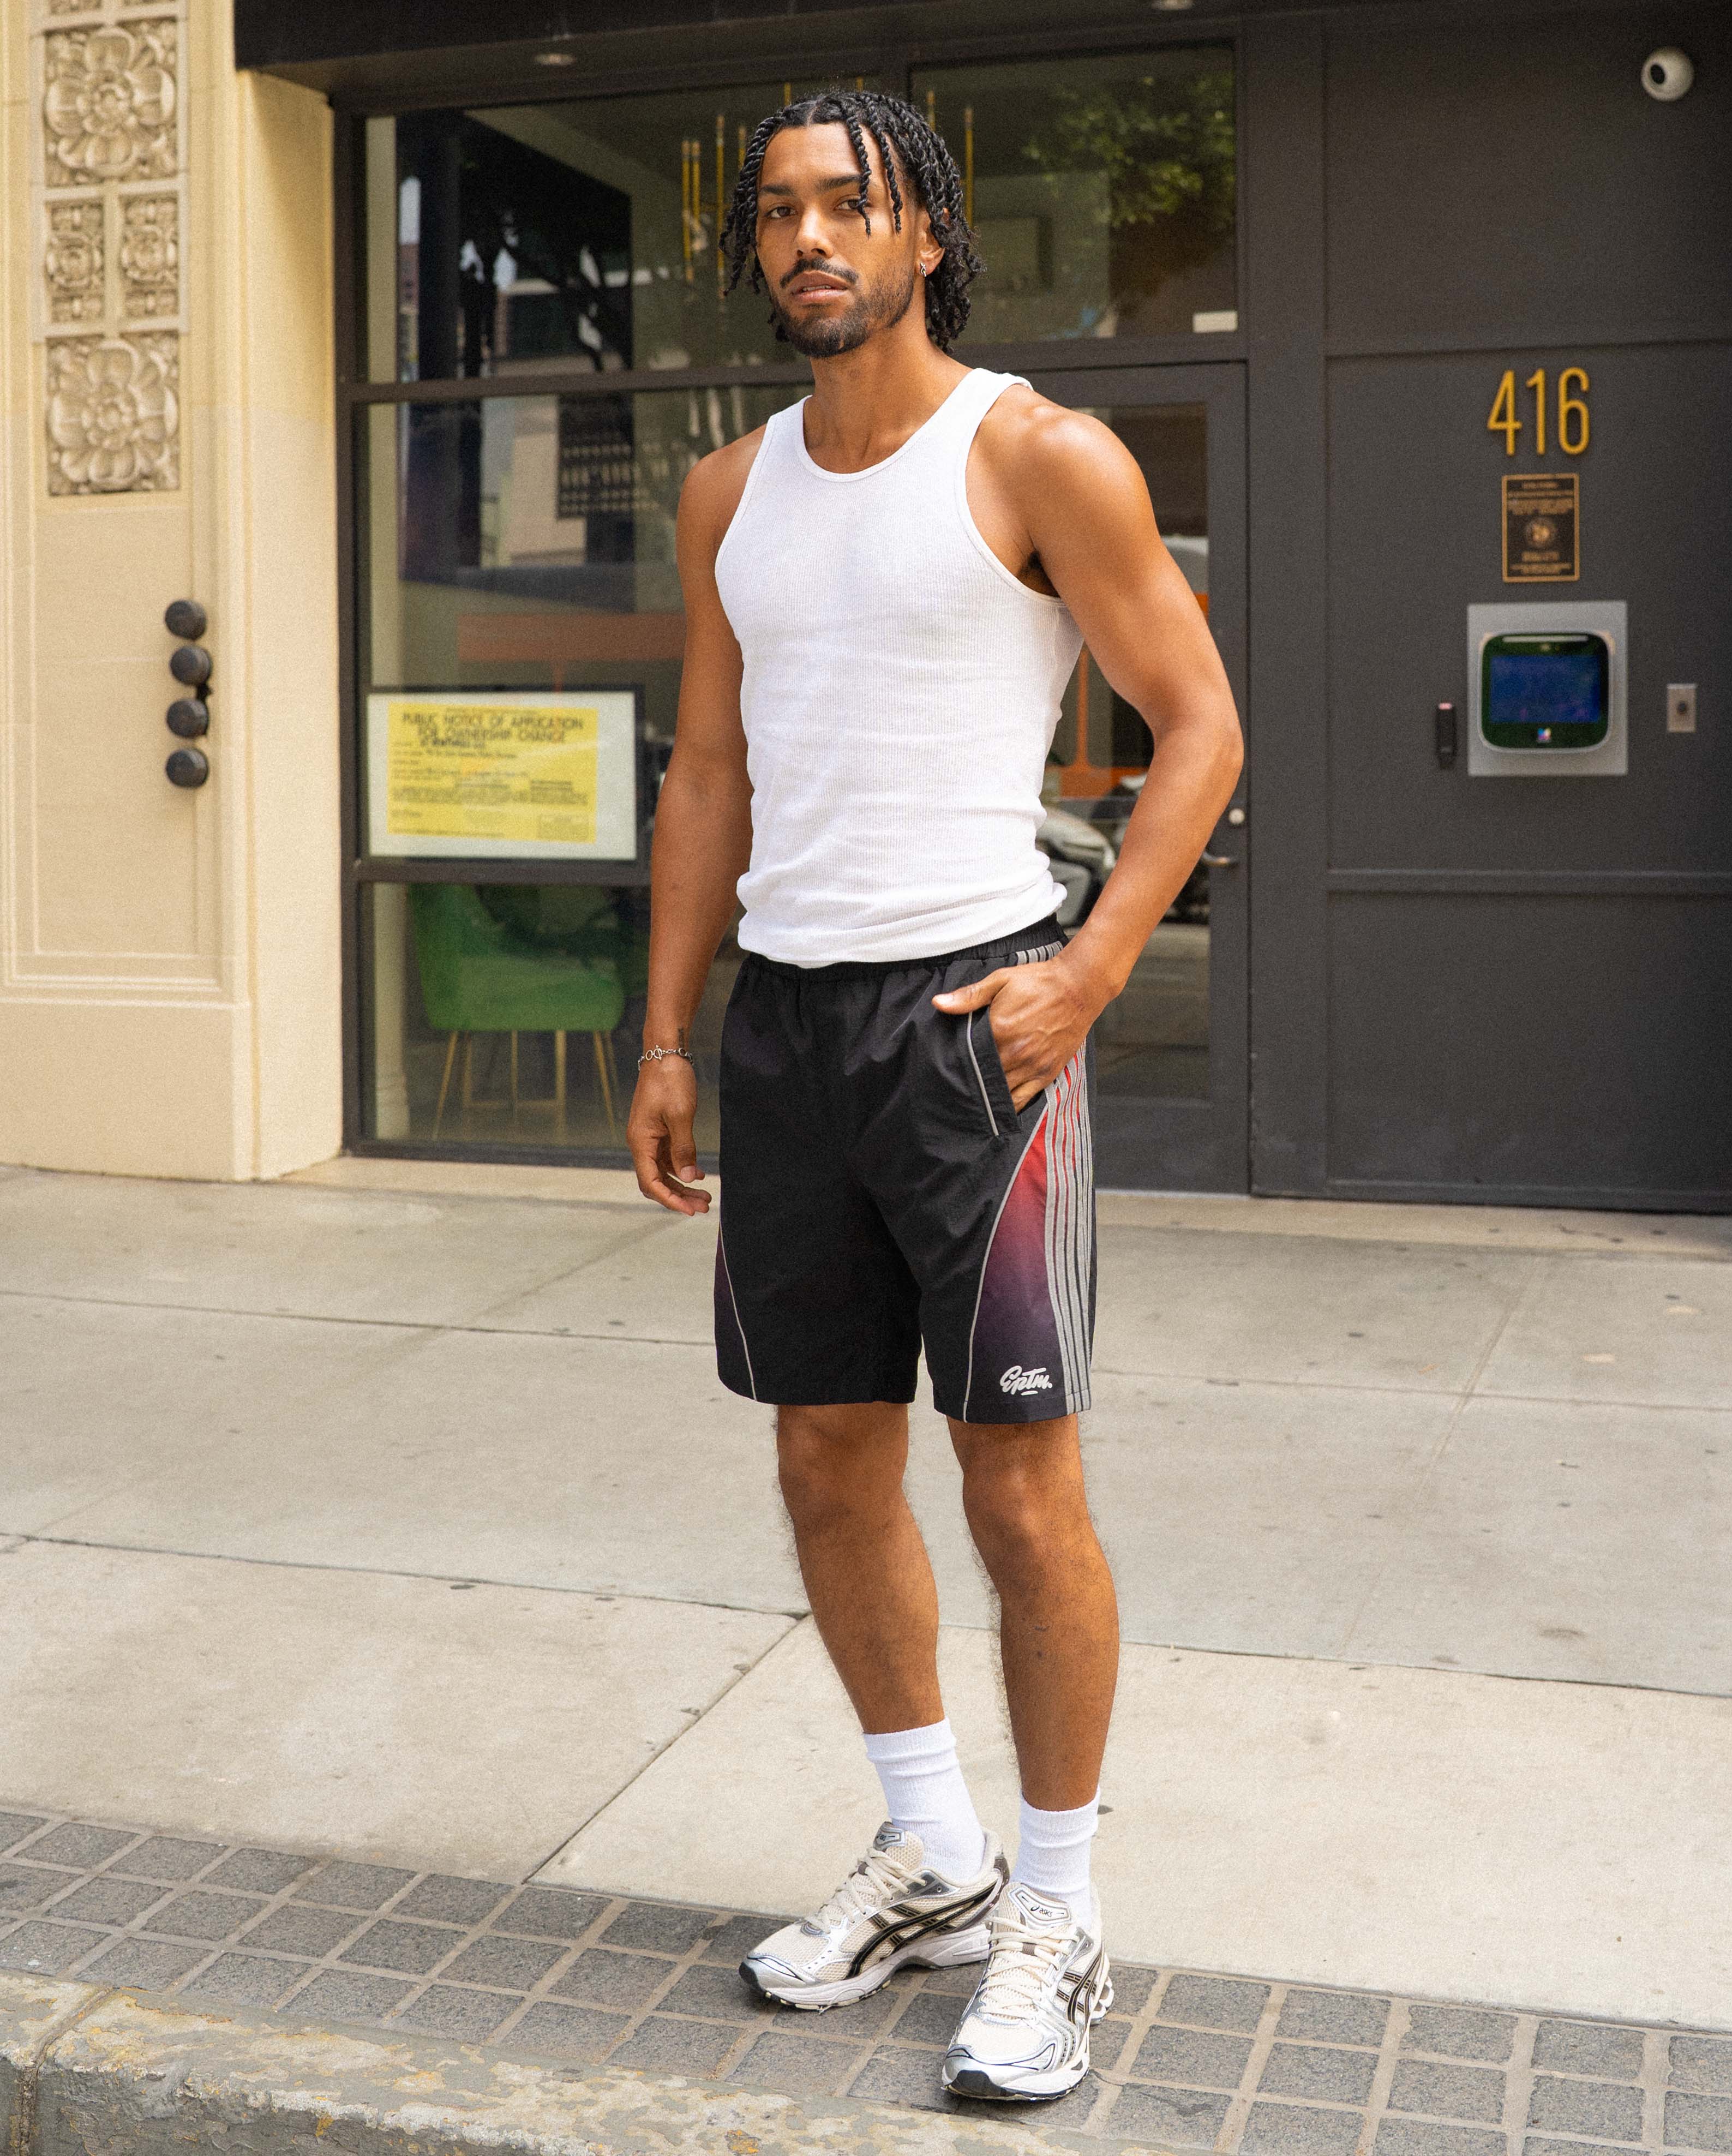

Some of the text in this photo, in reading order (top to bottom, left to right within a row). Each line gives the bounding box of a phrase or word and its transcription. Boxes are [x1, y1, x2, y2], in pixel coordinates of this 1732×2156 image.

[1487, 367, 1590, 456] 416
[401, 712, 583, 729] PUBLIC NOTICE OF APPLICATION
